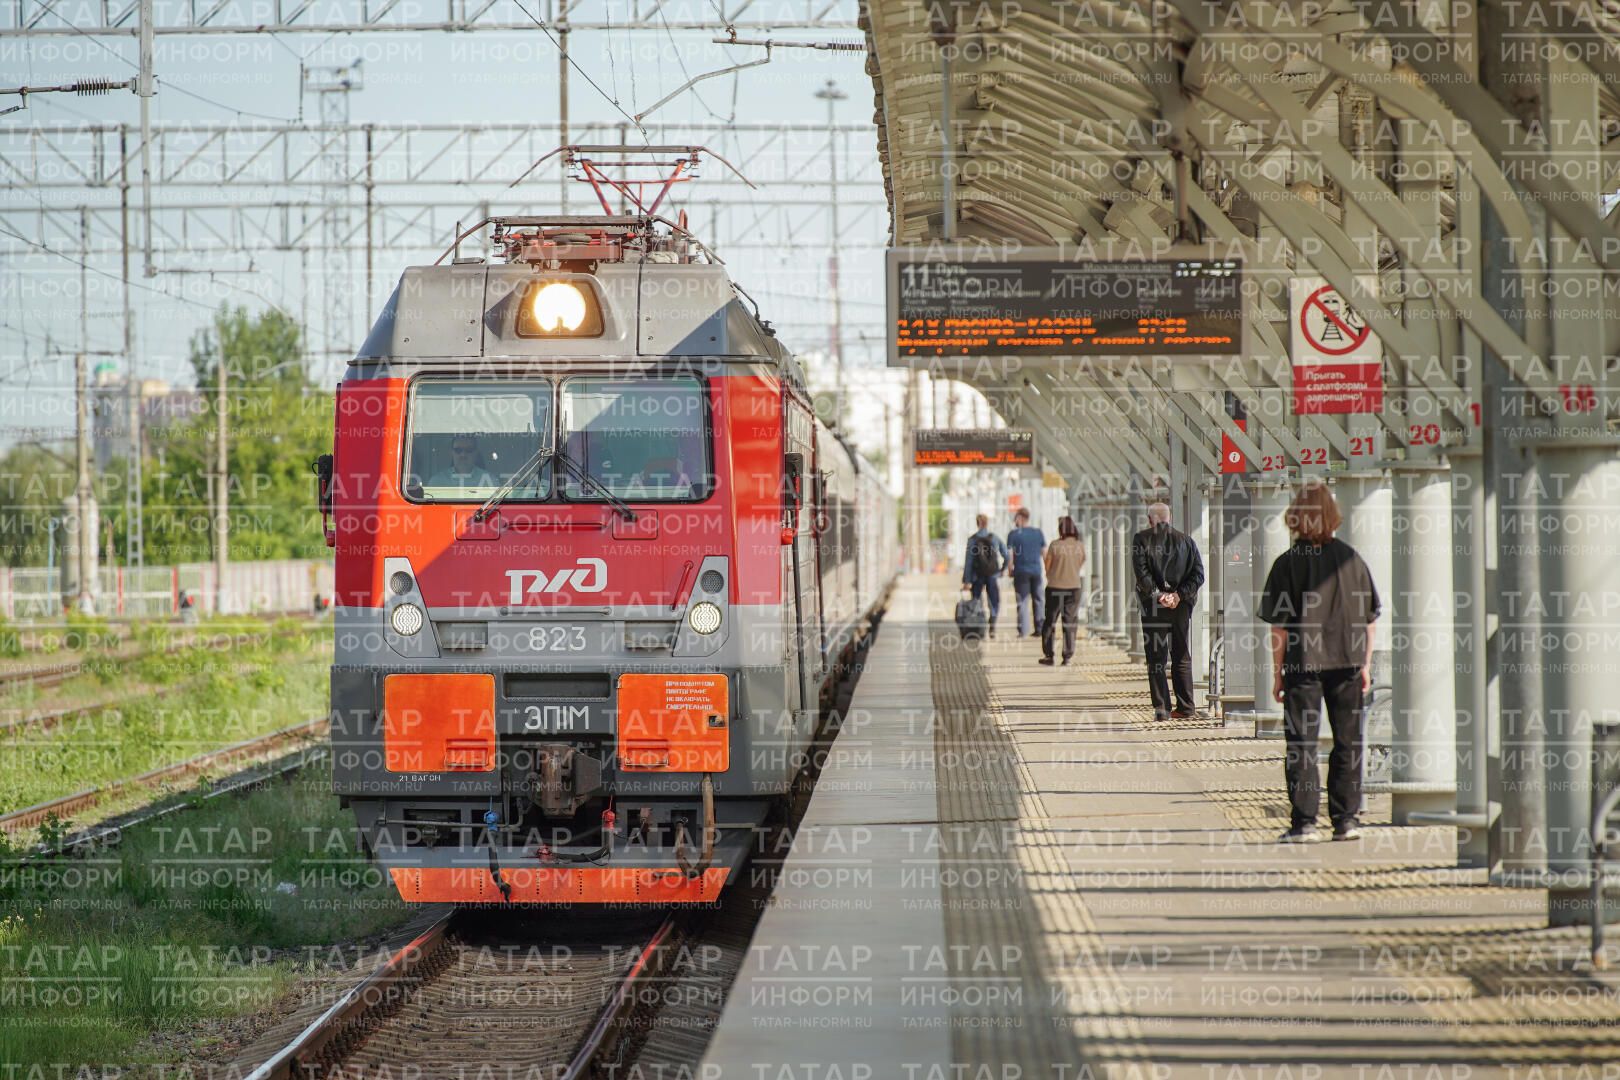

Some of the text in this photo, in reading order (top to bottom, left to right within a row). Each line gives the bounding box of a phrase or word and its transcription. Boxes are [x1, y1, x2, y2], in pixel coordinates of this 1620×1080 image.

[903, 264, 929, 288] 11
[936, 263, 968, 277] Путь
[1306, 371, 1346, 382] Прыгать
[1313, 381, 1368, 392] платформы
[1307, 392, 1363, 402] запрещено!
[1409, 423, 1440, 446] 20
[1349, 437, 1374, 455] 21
[1262, 455, 1285, 471] 23
[1300, 448, 1327, 464] 22
[529, 627, 586, 651] 823
[411, 774, 441, 782] ВАГОН
